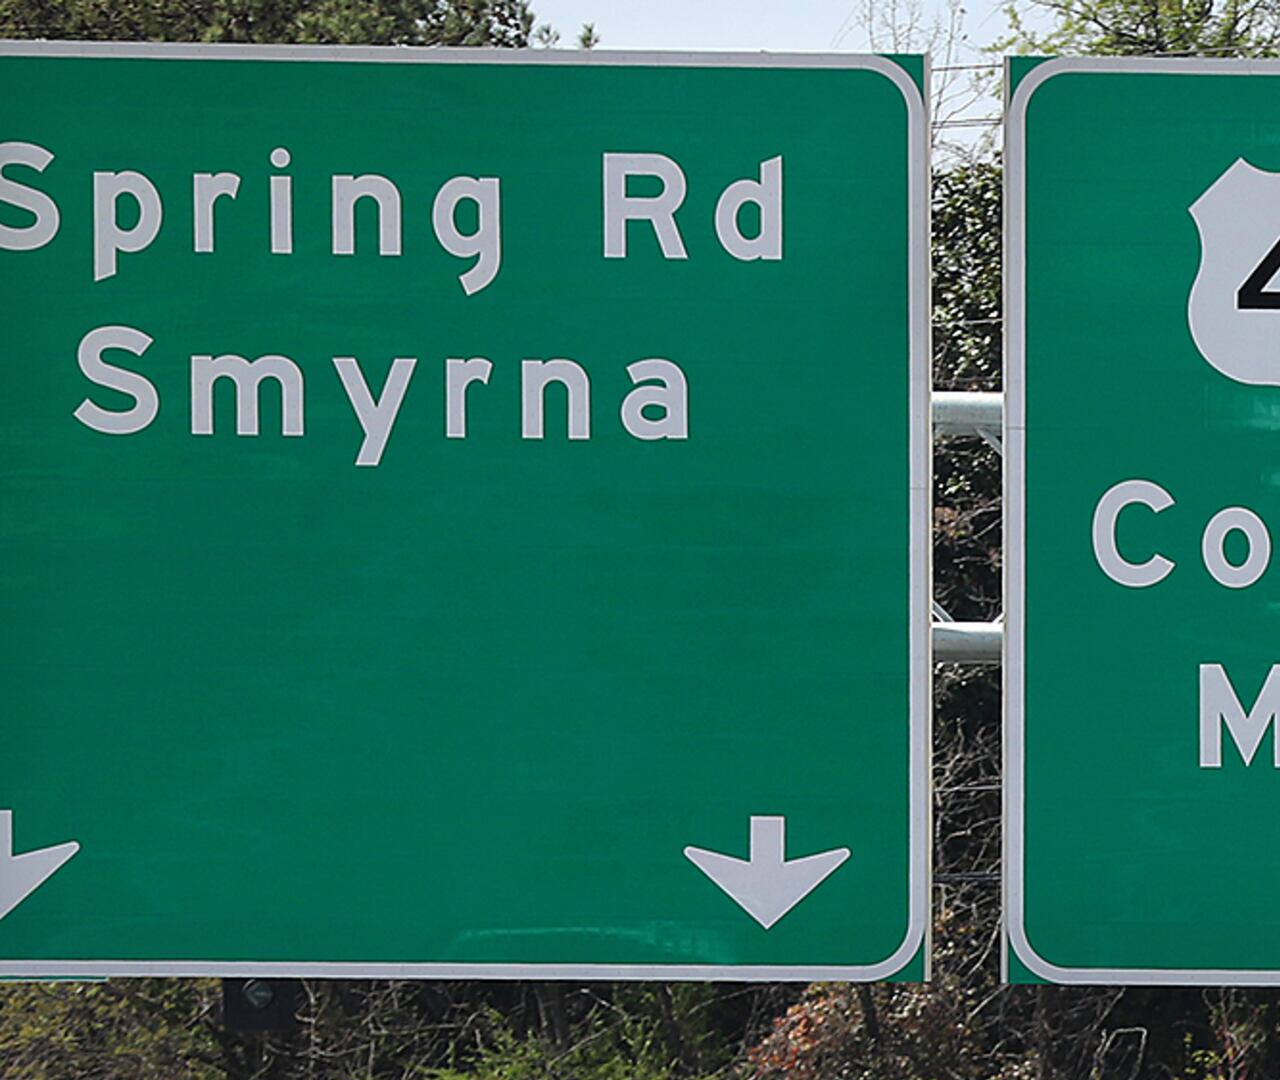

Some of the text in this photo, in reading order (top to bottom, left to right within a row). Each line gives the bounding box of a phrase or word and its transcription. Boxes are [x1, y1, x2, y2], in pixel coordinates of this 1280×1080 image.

[0, 141, 784, 296] Spring Rd
[73, 325, 689, 466] Smyrna
